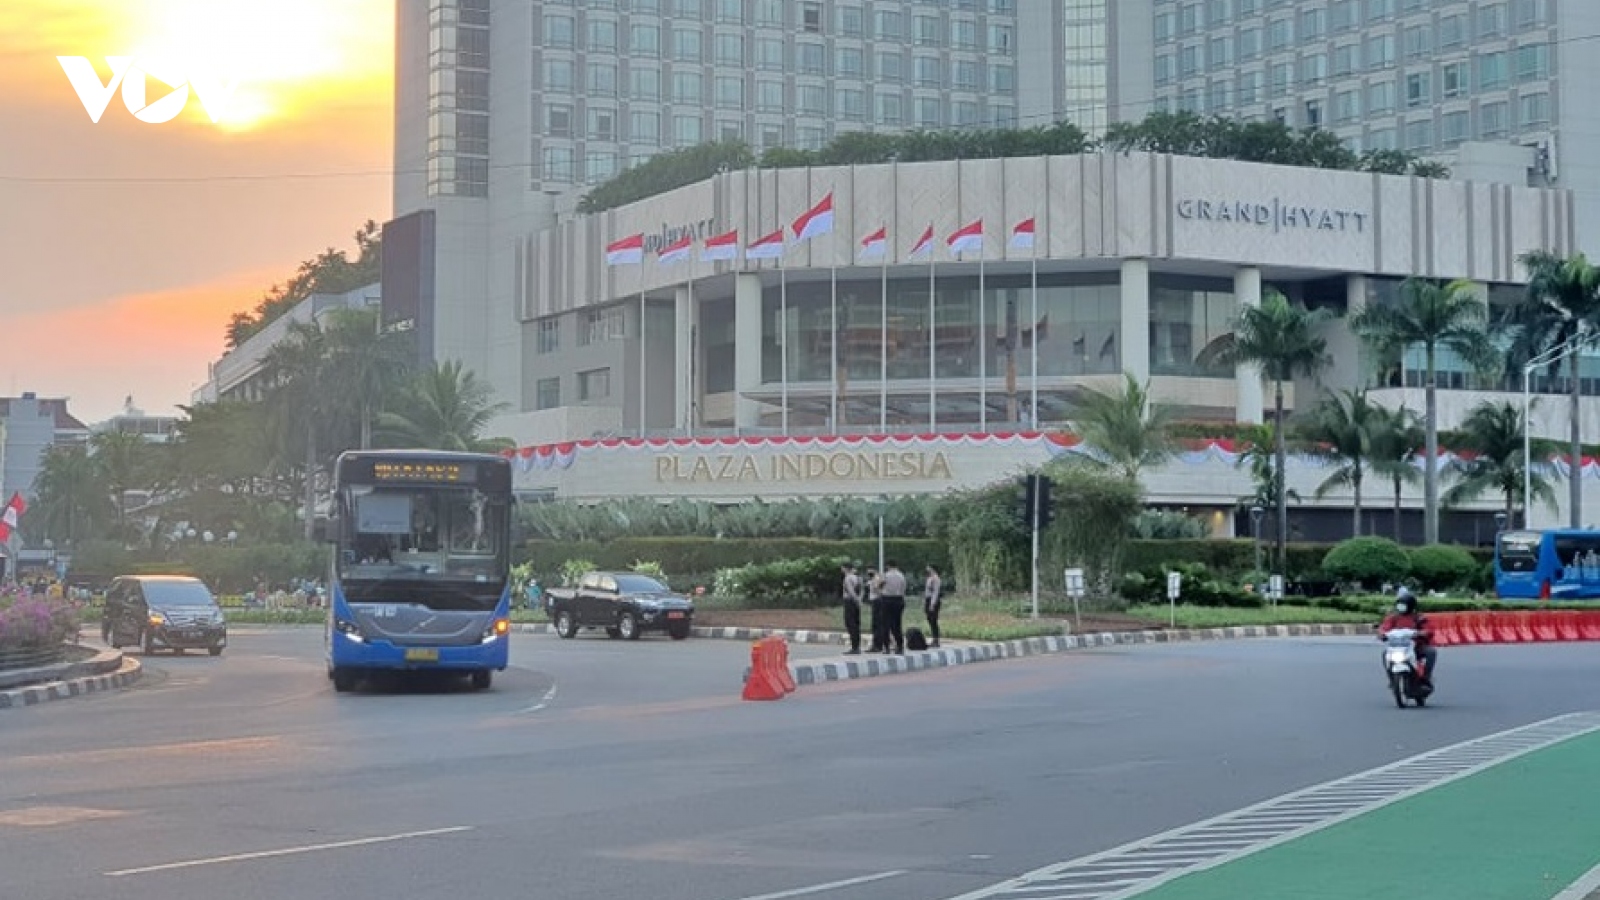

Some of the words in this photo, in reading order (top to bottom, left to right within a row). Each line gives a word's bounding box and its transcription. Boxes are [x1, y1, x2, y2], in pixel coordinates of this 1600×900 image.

[1177, 199, 1270, 226] GRAND
[1282, 205, 1369, 233] HYATT
[655, 454, 762, 482] PLAZA
[770, 452, 952, 481] INDONESIA
